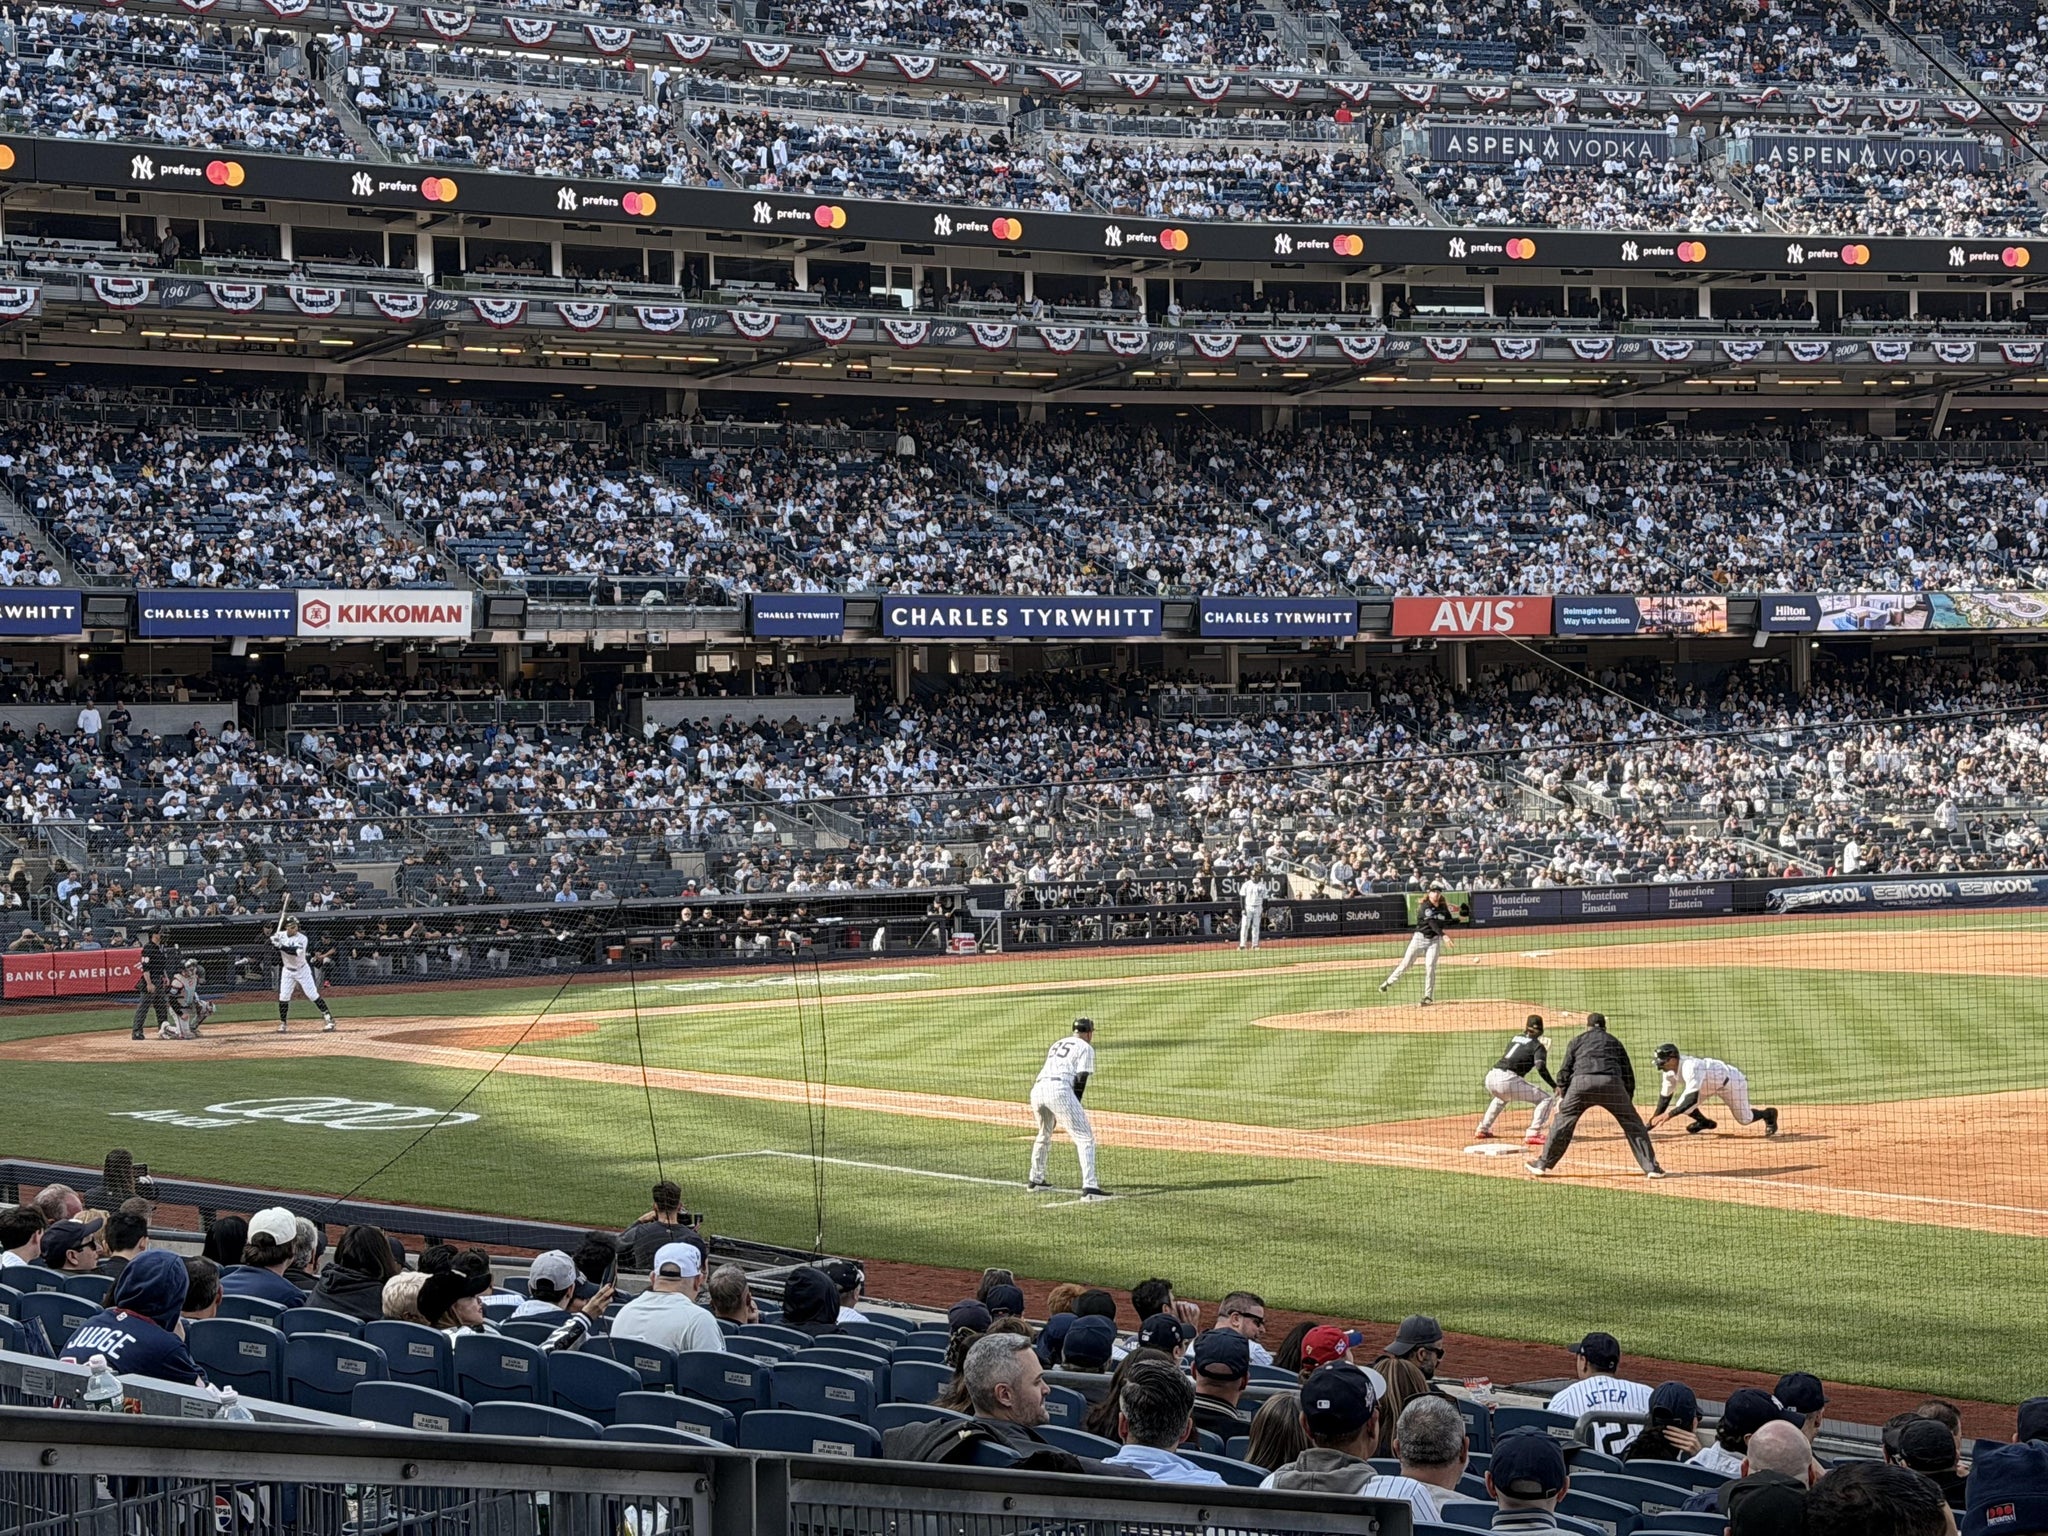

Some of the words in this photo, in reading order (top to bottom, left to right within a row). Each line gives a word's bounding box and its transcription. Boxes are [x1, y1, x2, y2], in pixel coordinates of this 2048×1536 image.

[1447, 134, 1533, 155] ASPEN
[1568, 139, 1654, 159] VODKA
[1768, 145, 1850, 164] ASPEN
[1883, 147, 1966, 168] VODKA
[160, 165, 202, 177] prefers
[378, 180, 418, 192] prefers
[582, 195, 618, 206] prefers
[776, 209, 811, 220] prefers
[956, 222, 988, 232] prefers
[1126, 233, 1157, 243] prefers
[1296, 240, 1330, 250] prefers
[1470, 244, 1502, 254] prefers
[1643, 247, 1674, 257] prefers
[1808, 250, 1838, 260] prefers
[1969, 252, 1999, 262] prefers
[162, 285, 191, 299] 1961
[428, 298, 459, 311] 1962
[691, 315, 717, 329] 1977
[931, 326, 957, 337] 1978
[1152, 340, 1176, 352] 1996
[1385, 340, 1411, 351] 1998
[1616, 342, 1640, 353] 1999
[1835, 343, 1859, 357] 2000
[0, 605, 75, 619] WHITT
[144, 608, 209, 619] CHARLES
[215, 608, 291, 619] TYRWHITT
[337, 604, 462, 624] KIKKOMAN
[757, 611, 794, 620] CHARLES
[797, 611, 840, 620] TYRWHITT
[1429, 600, 1515, 632] AVIS
[1563, 607, 1602, 616] Reimagine
[1603, 607, 1617, 615] the
[1775, 605, 1806, 616] Hilton
[891, 607, 1009, 627] CHARLES
[1020, 608, 1154, 627] TYRWHITT
[1204, 611, 1270, 624] CHARLES
[1275, 612, 1353, 624] TYRWHITT
[1563, 617, 1582, 627] Way
[1597, 617, 1630, 626] Vacation
[1221, 878, 1280, 894] Stub
[1669, 885, 1715, 897] Montefiore
[1907, 883, 1953, 899] COOL
[1994, 878, 2038, 893] COOL
[1492, 894, 1540, 905] Montefiore
[1582, 889, 1629, 901] Montefiore
[1822, 886, 1866, 904] COOL
[1581, 902, 1616, 914] Einstein
[1668, 898, 1702, 910] Einstein
[1304, 911, 1338, 923] StubHub
[1346, 910, 1380, 921] StubHub
[1492, 905, 1528, 917] Einstein
[6, 970, 44, 982] BANK
[47, 970, 65, 980] OF
[69, 966, 131, 980] AMERICA
[67, 1326, 137, 1360] JUDGE
[1586, 1388, 1628, 1408] JETER
[215, 1507, 231, 1516] EPSI
